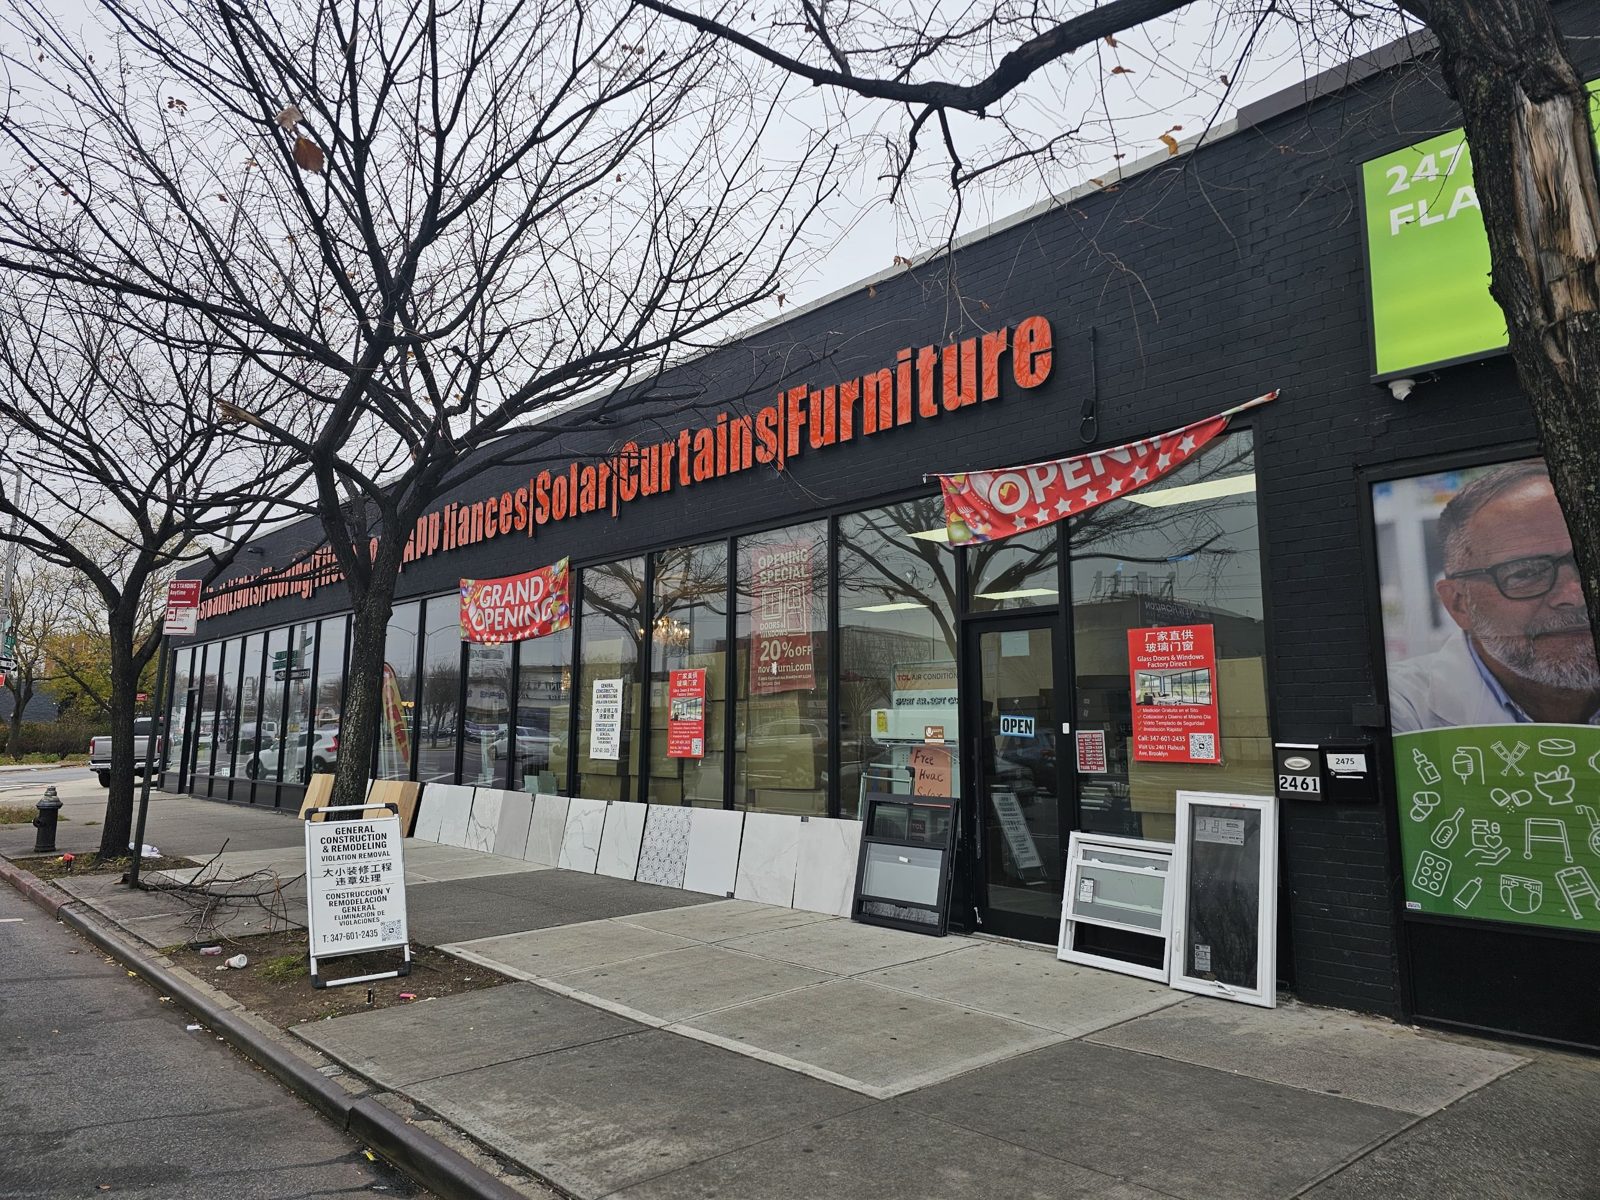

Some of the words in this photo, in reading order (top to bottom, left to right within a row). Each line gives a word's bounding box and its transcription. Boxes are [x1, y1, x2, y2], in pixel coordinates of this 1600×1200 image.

[1386, 142, 1470, 196] 247
[535, 460, 612, 525] Solar
[620, 406, 778, 502] Curtains
[787, 315, 1052, 457] Furniture
[758, 548, 808, 569] OPENING
[760, 564, 808, 583] SPECIAL
[480, 575, 544, 608] GRAND
[472, 597, 553, 631] OPENING
[1145, 629, 1194, 642] 厂家直供
[795, 645, 812, 656] OFF
[1145, 641, 1194, 652] 玻璃门窗
[1177, 653, 1204, 661] Windows
[1002, 717, 1033, 734] OPEN
[914, 750, 934, 766] Free
[1149, 750, 1168, 758] Brooklyn
[1335, 757, 1355, 765] 2475
[1280, 776, 1318, 792] 2461
[335, 825, 375, 835] GENERAL
[320, 832, 387, 845] CONSTRUCTION
[331, 841, 387, 853] REMODELING
[321, 853, 357, 862] VIOLATION
[358, 850, 391, 860] REMOVAL
[323, 862, 392, 877] 大小装修工程
[335, 873, 381, 886] 违章处理
[341, 904, 376, 913] GENERAL
[339, 917, 380, 926] VIOLACIONES
[322, 934, 329, 943] T:
[330, 929, 379, 943] 347-601-2435
